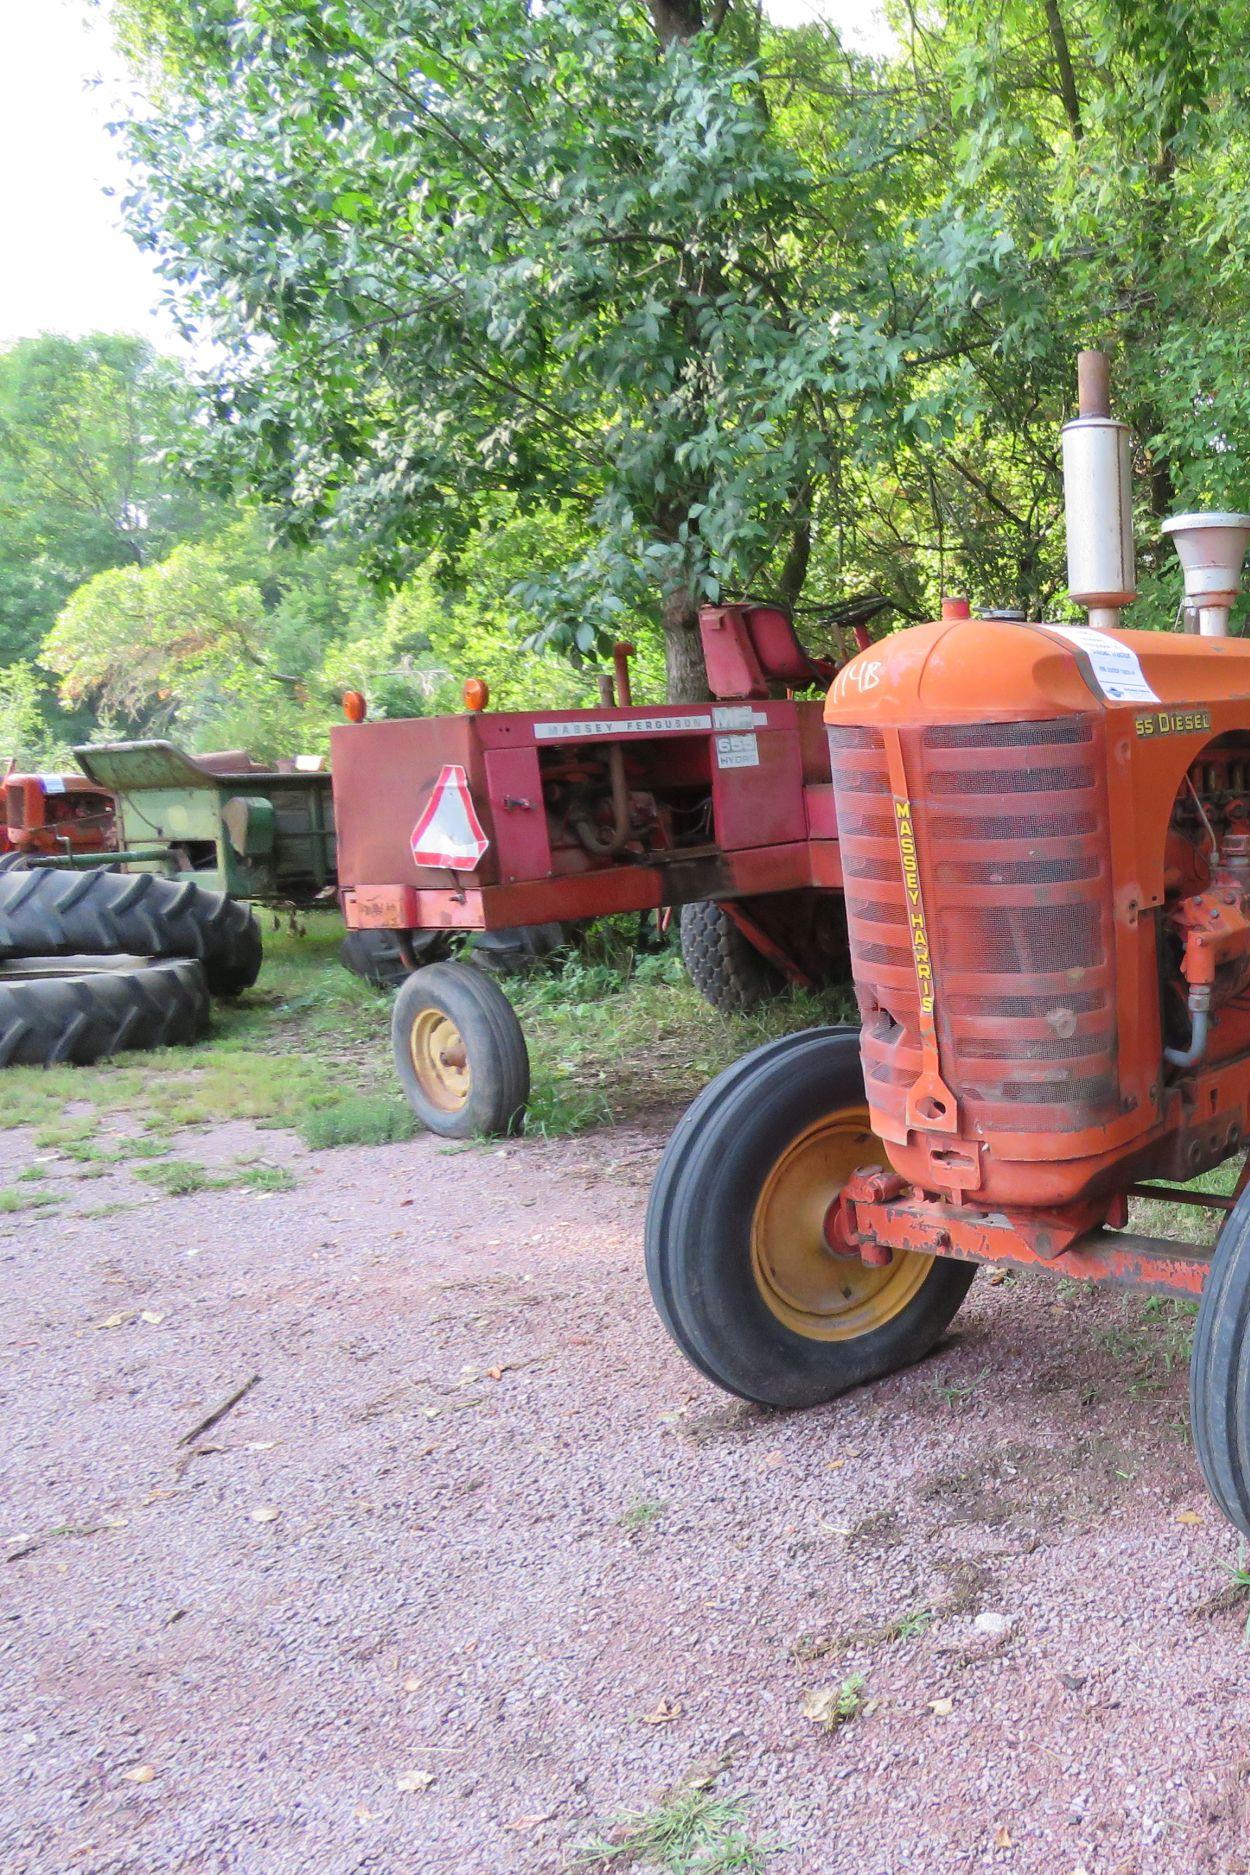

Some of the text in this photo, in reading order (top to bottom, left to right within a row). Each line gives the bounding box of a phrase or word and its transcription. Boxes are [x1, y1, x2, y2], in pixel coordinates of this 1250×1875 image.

[547, 717, 701, 736] MASSEY FERGUSON
[1136, 712, 1210, 735] 55 DIESEL
[895, 802, 935, 1013] MASSEY HARRIS
